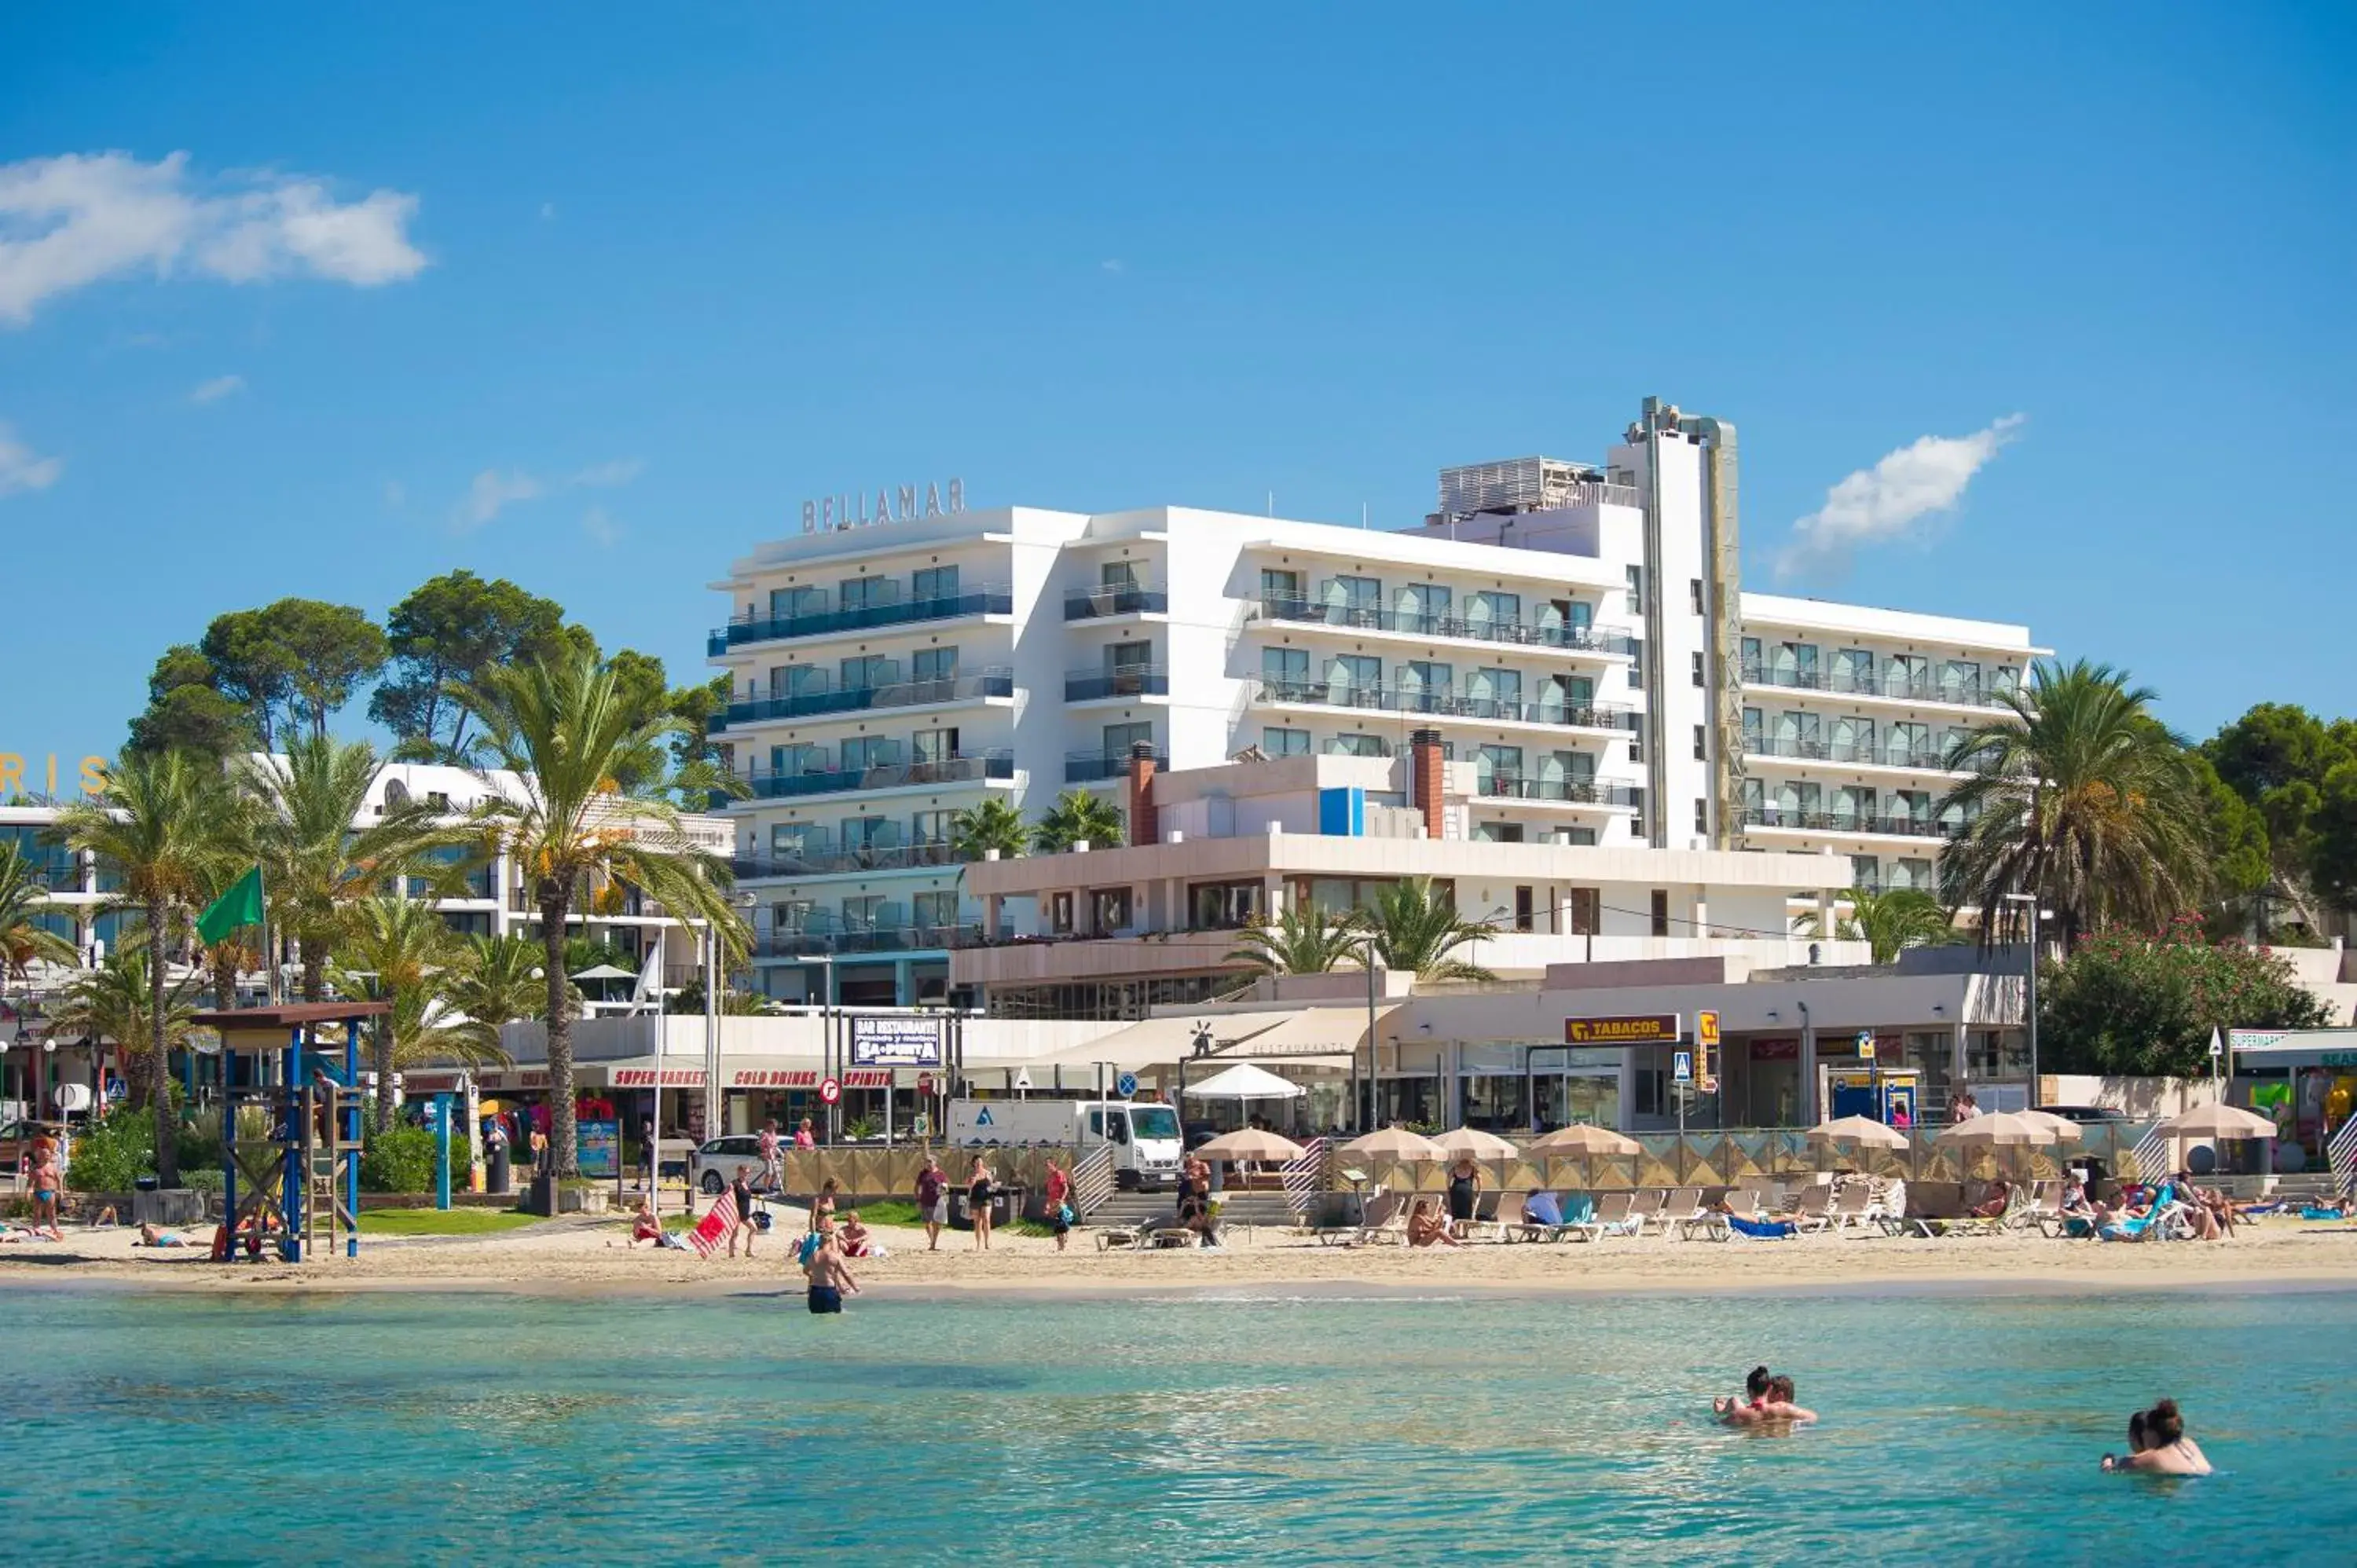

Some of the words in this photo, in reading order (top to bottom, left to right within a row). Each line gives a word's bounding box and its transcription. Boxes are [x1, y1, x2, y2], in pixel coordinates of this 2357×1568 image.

[802, 477, 966, 537] BELLAMAR
[857, 1020, 876, 1035] BAR
[877, 1020, 936, 1035] RESTAURANTE
[1594, 1021, 1660, 1035] TABACOS
[735, 1071, 767, 1085] COLD
[770, 1071, 817, 1085] DRINKS
[844, 1071, 892, 1086] SPIRITS
